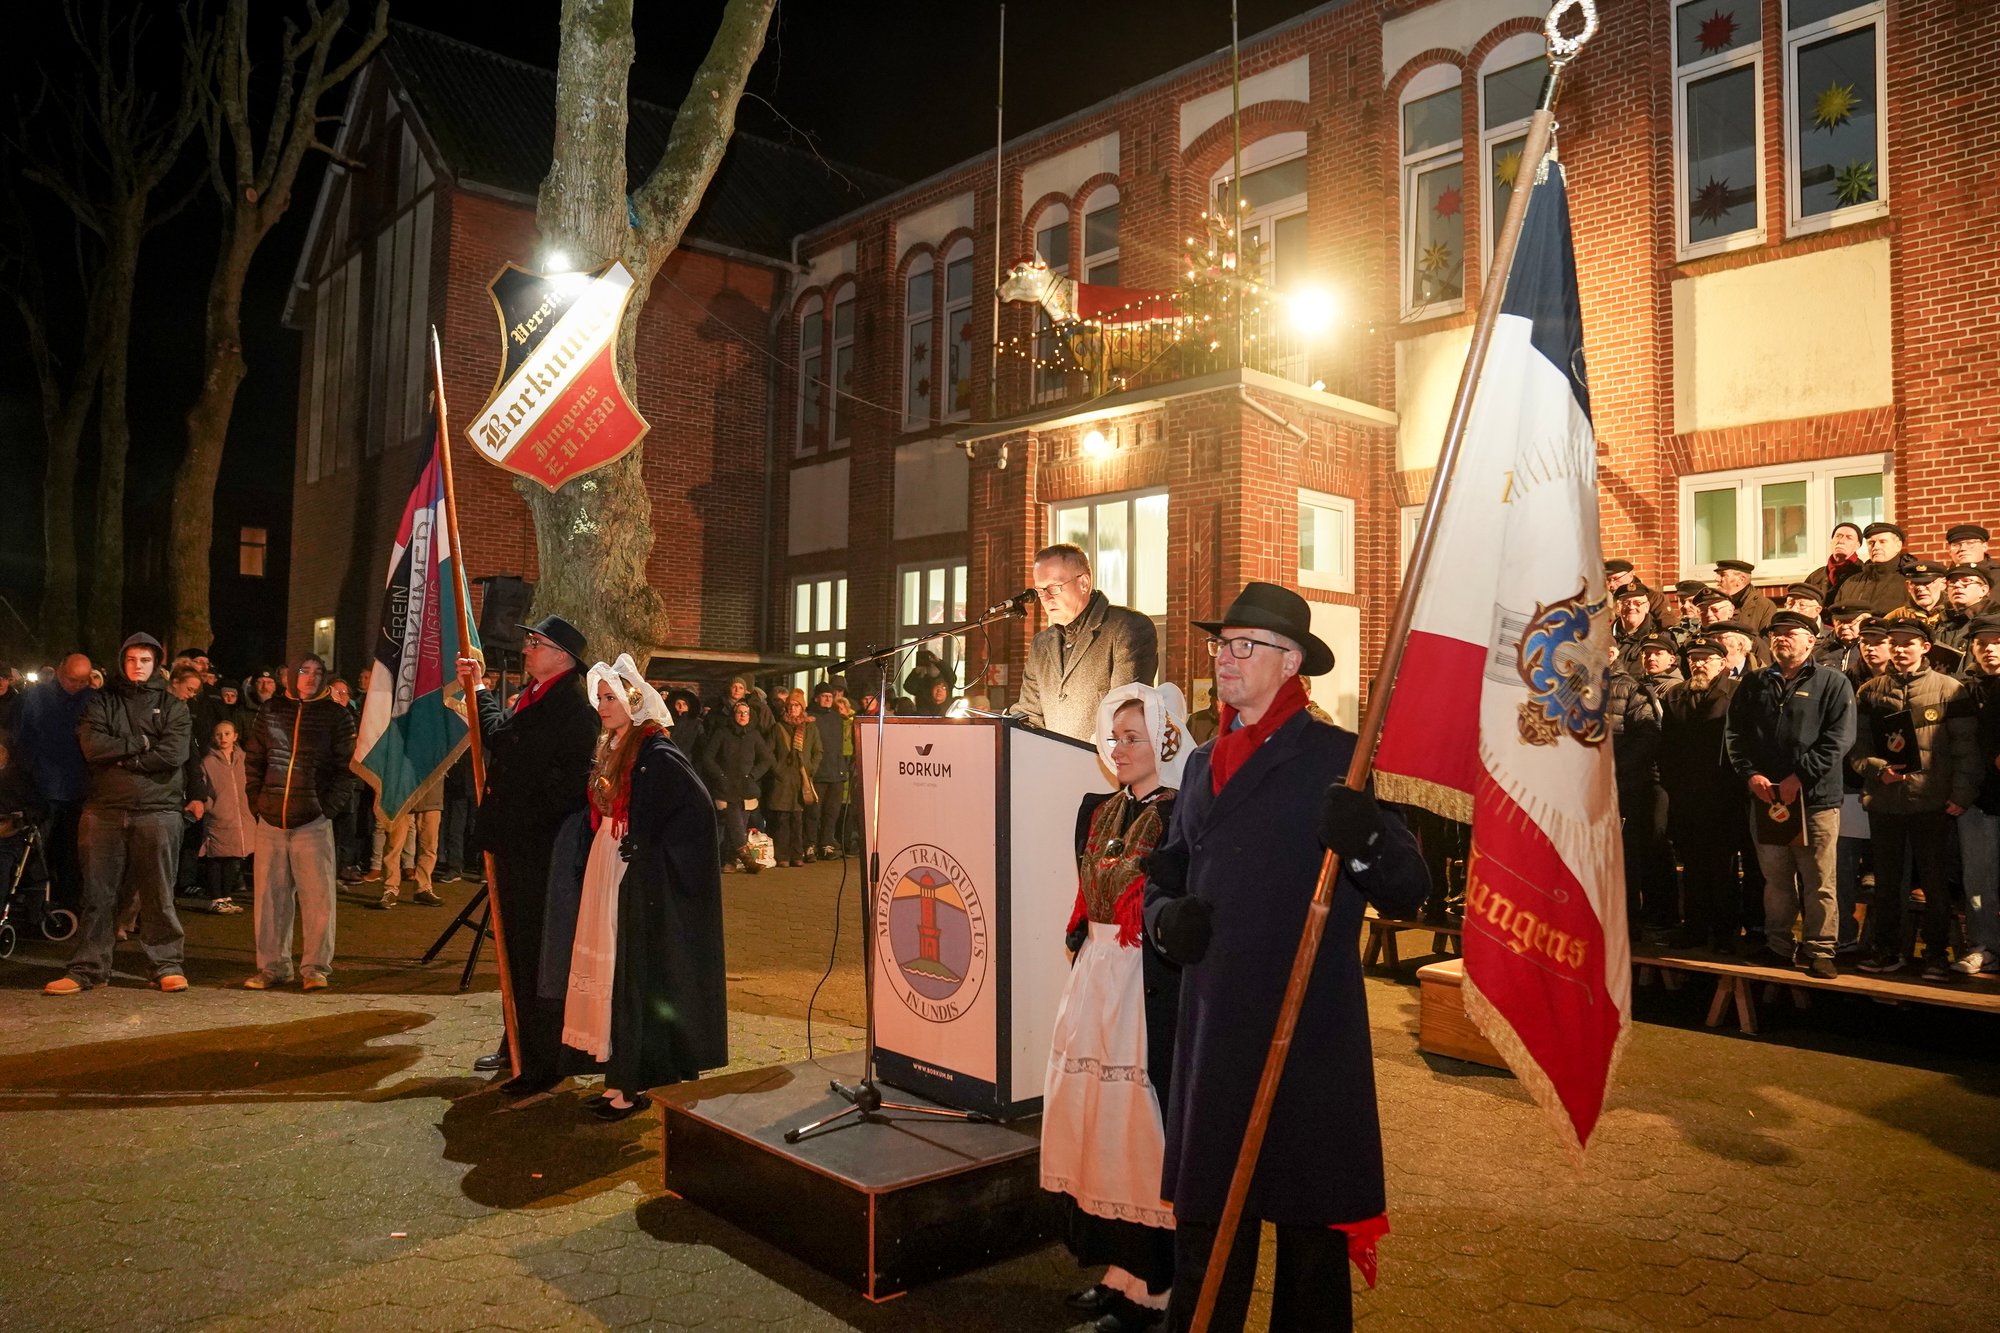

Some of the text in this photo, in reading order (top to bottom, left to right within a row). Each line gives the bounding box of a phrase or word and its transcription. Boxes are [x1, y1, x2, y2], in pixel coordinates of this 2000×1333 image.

[479, 304, 612, 454] Borkume
[530, 384, 598, 462] Jungens
[383, 585, 408, 658] VEREIN
[899, 761, 952, 778] BORKUM
[878, 848, 985, 960] MEDIIS TRANQUILLUS
[906, 990, 959, 1020] IN UNDIS
